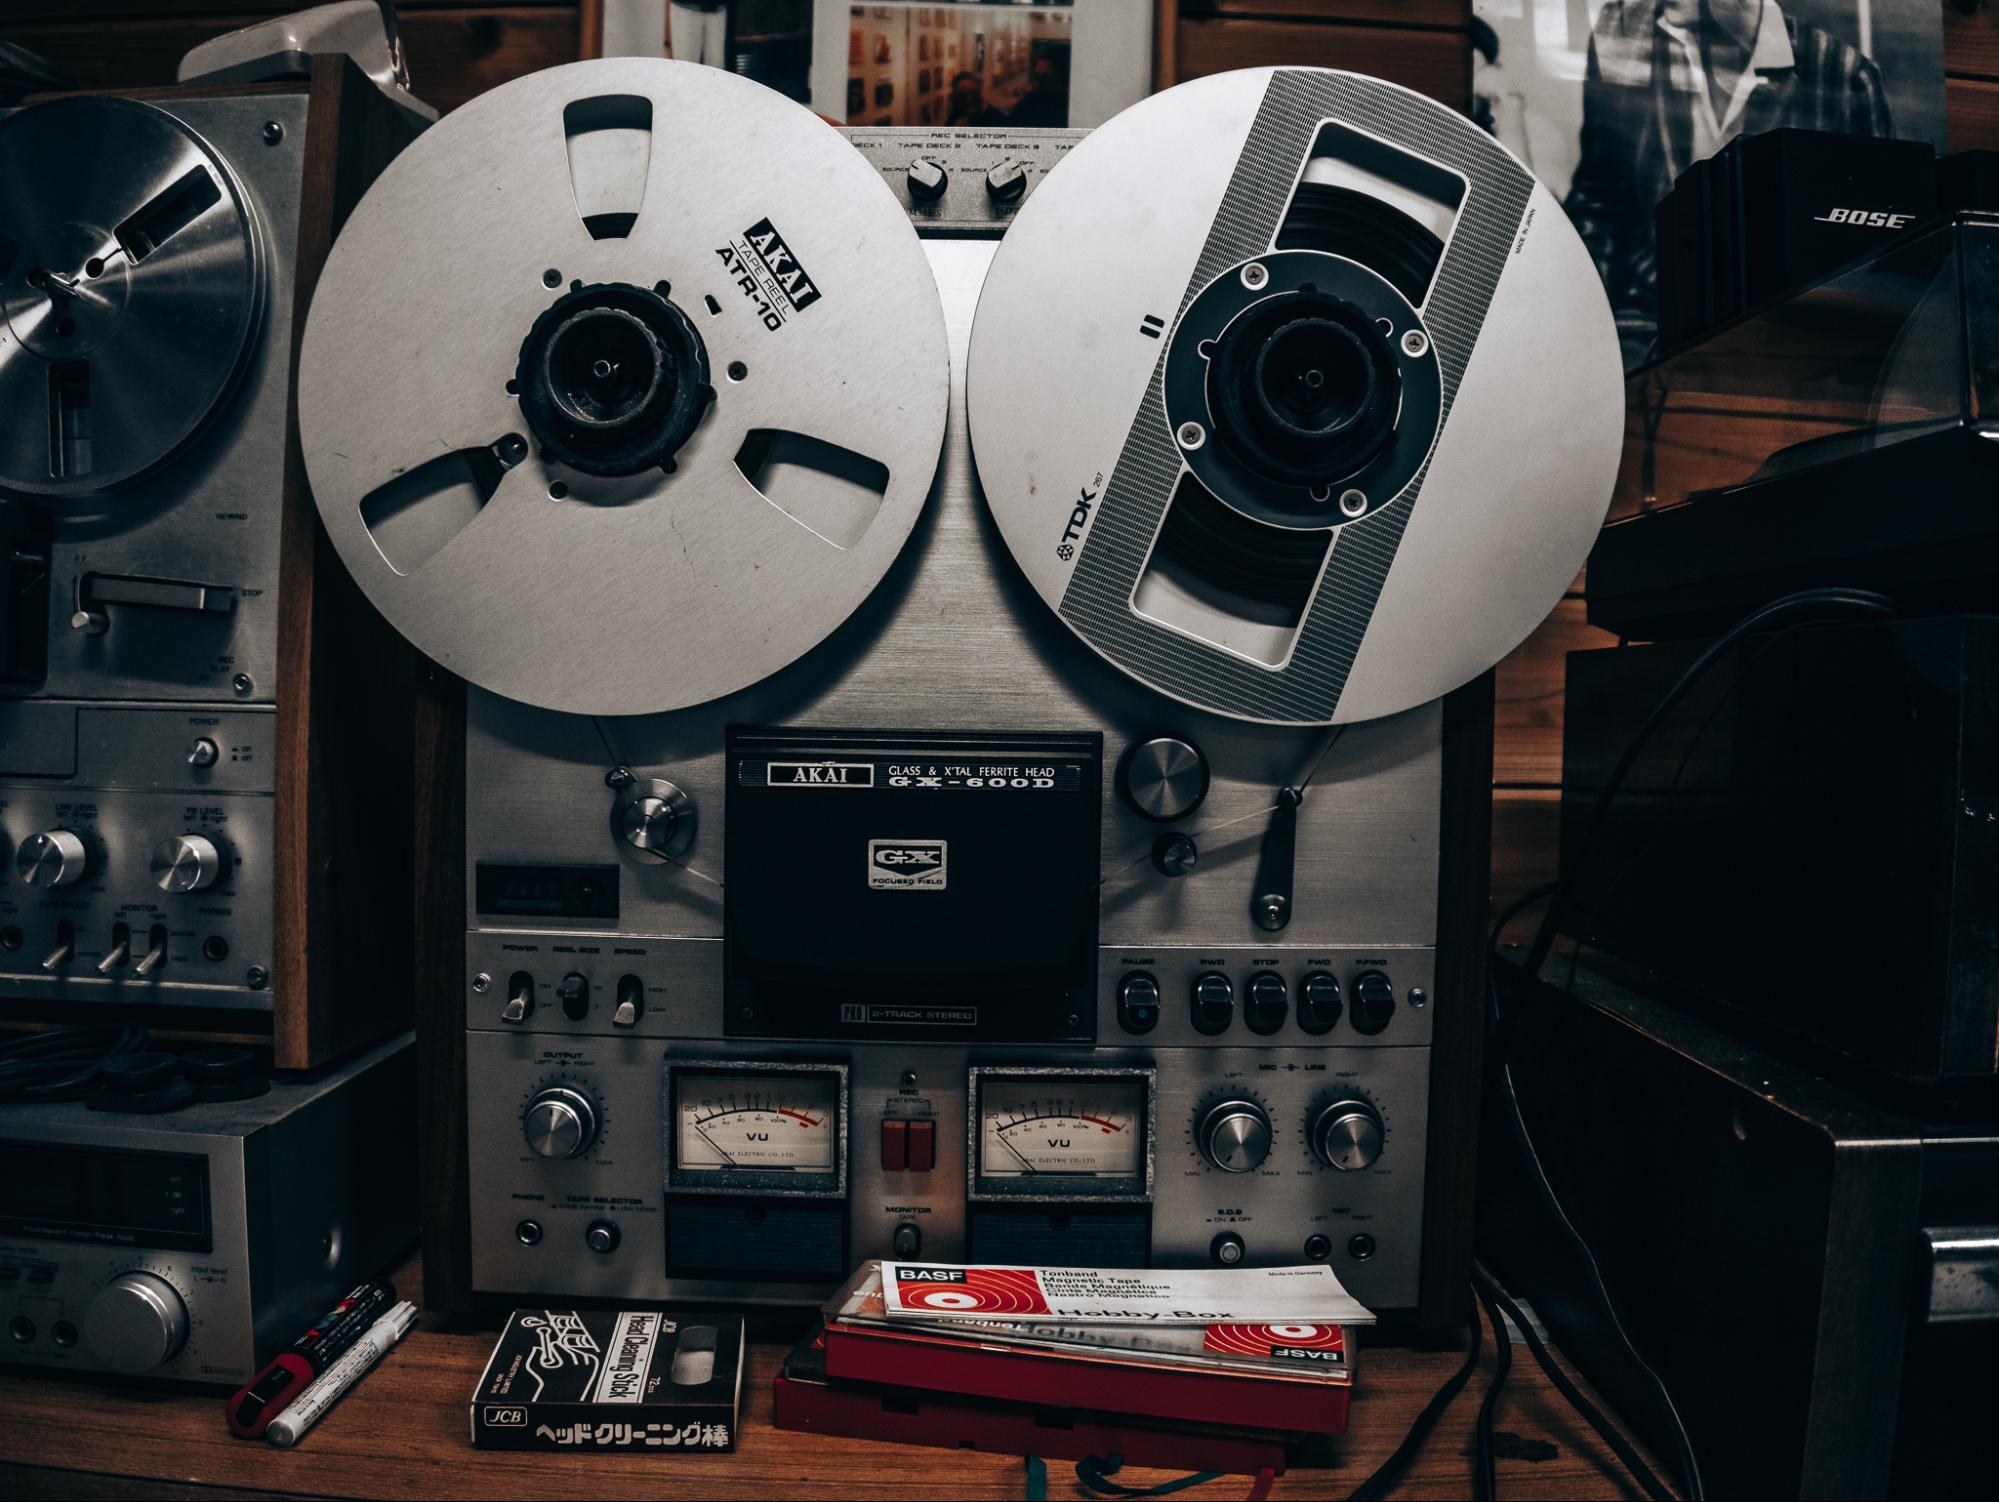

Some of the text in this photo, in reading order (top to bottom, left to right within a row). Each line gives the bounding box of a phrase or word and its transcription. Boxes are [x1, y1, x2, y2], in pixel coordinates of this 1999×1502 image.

[1814, 208, 1916, 229] BOSE
[750, 231, 813, 304] AKAI
[738, 240, 790, 315] TAPE REEL
[715, 248, 782, 332] ATR-10
[1061, 472, 1104, 543] TDK 267
[793, 767, 847, 783] AKAI
[889, 766, 1054, 777] GLASS & X'TAL FERRITE HEAD
[875, 850, 940, 864] GX
[120, 904, 158, 912] MONITOR
[502, 944, 538, 952] POWER
[926, 1011, 972, 1020] STEREO
[746, 1133, 769, 1141] VU
[1048, 1139, 1070, 1148] VU
[900, 1270, 964, 1281] BASF
[1043, 1277, 1104, 1285] Magnetic
[1058, 1309, 1234, 1320] Hobby-Box
[609, 1316, 654, 1398] Head Cleaning Stick
[1275, 1349, 1337, 1361] BASF
[490, 1411, 521, 1423] JCB
[536, 1421, 729, 1447] ヘッドクリーニング棒
